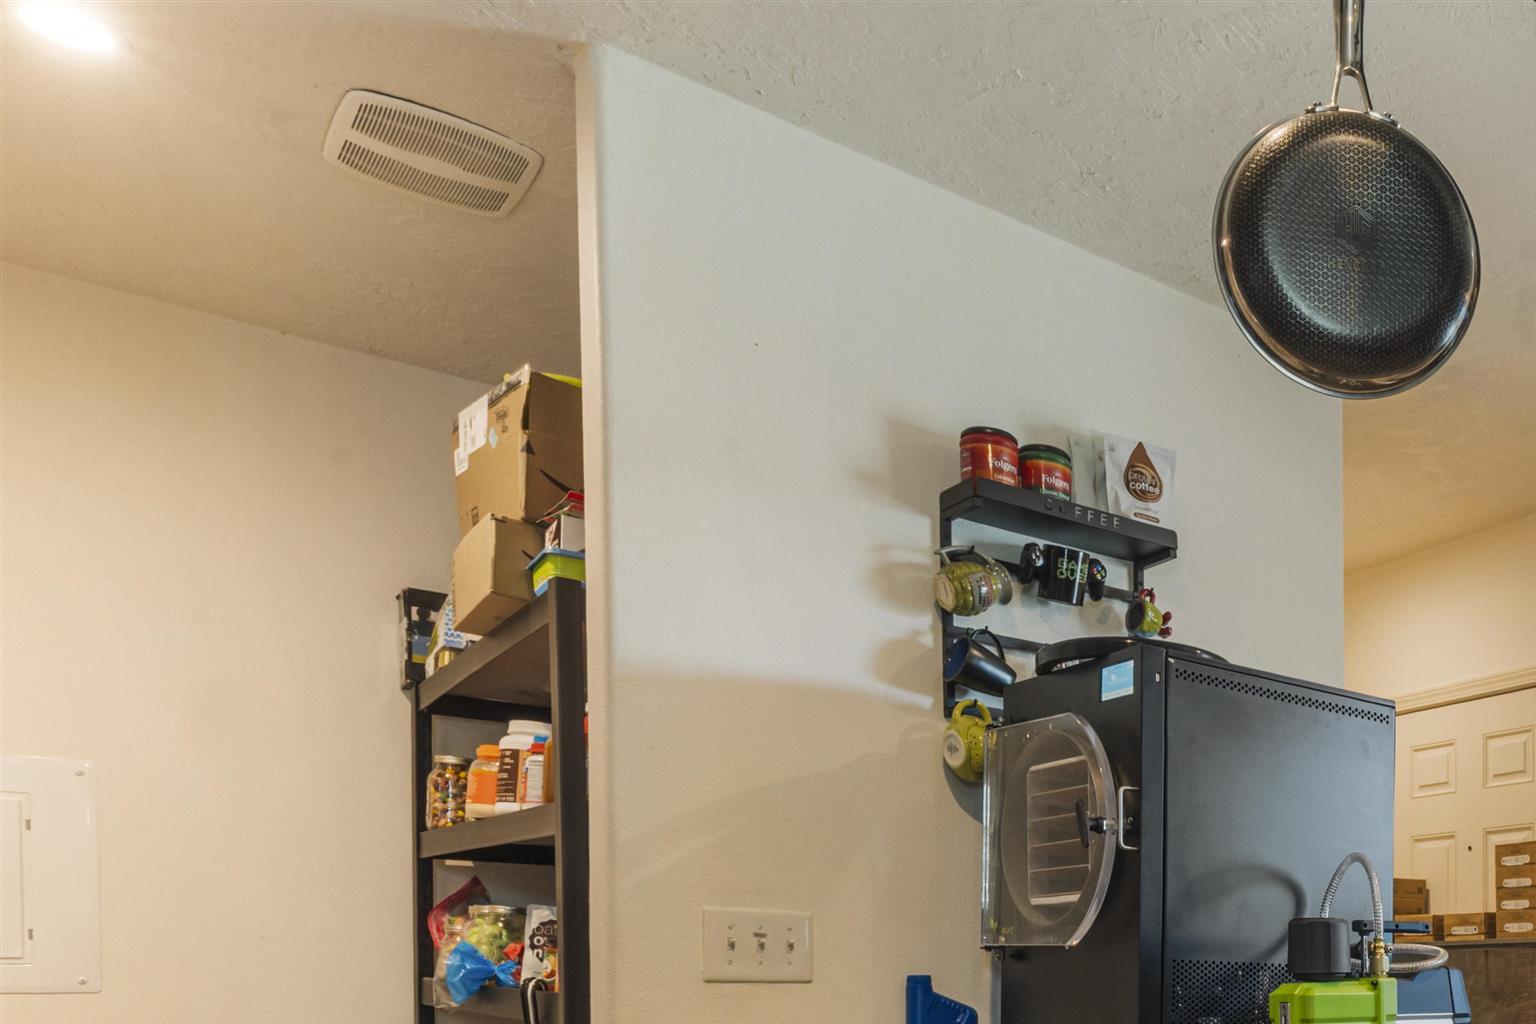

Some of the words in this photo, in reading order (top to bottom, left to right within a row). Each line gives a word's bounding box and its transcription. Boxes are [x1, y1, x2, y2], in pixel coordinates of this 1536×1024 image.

[990, 457, 1018, 476] Folgers
[1042, 473, 1070, 490] Folgers
[1129, 481, 1160, 495] coffee
